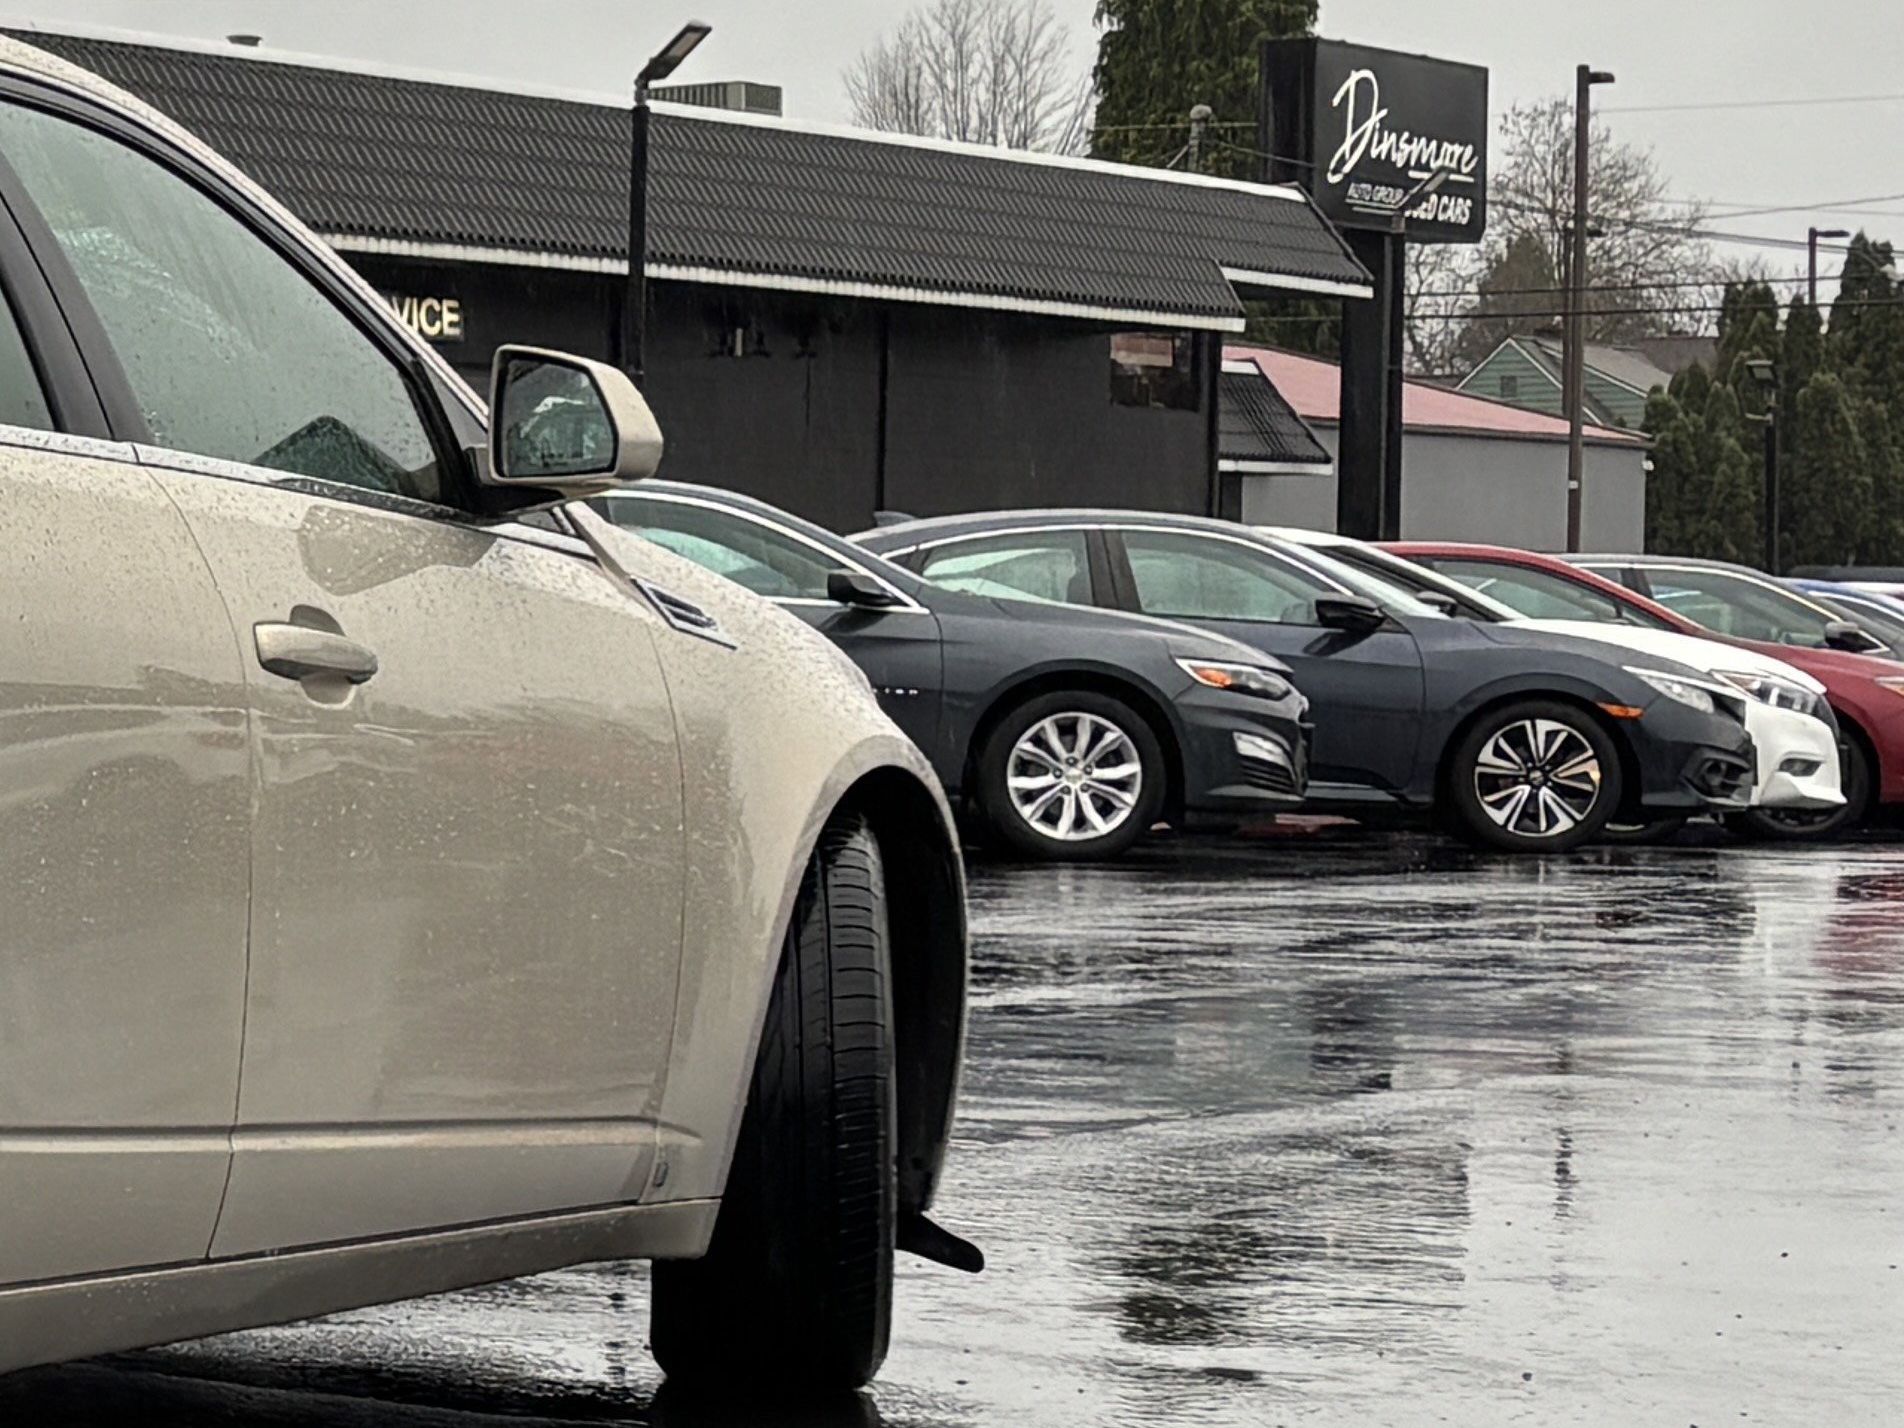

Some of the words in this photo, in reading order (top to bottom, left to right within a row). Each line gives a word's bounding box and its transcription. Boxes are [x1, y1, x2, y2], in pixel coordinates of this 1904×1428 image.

[1326, 68, 1478, 184] Dinsmore
[1438, 195, 1472, 225] CARS
[392, 296, 461, 336] VICE
